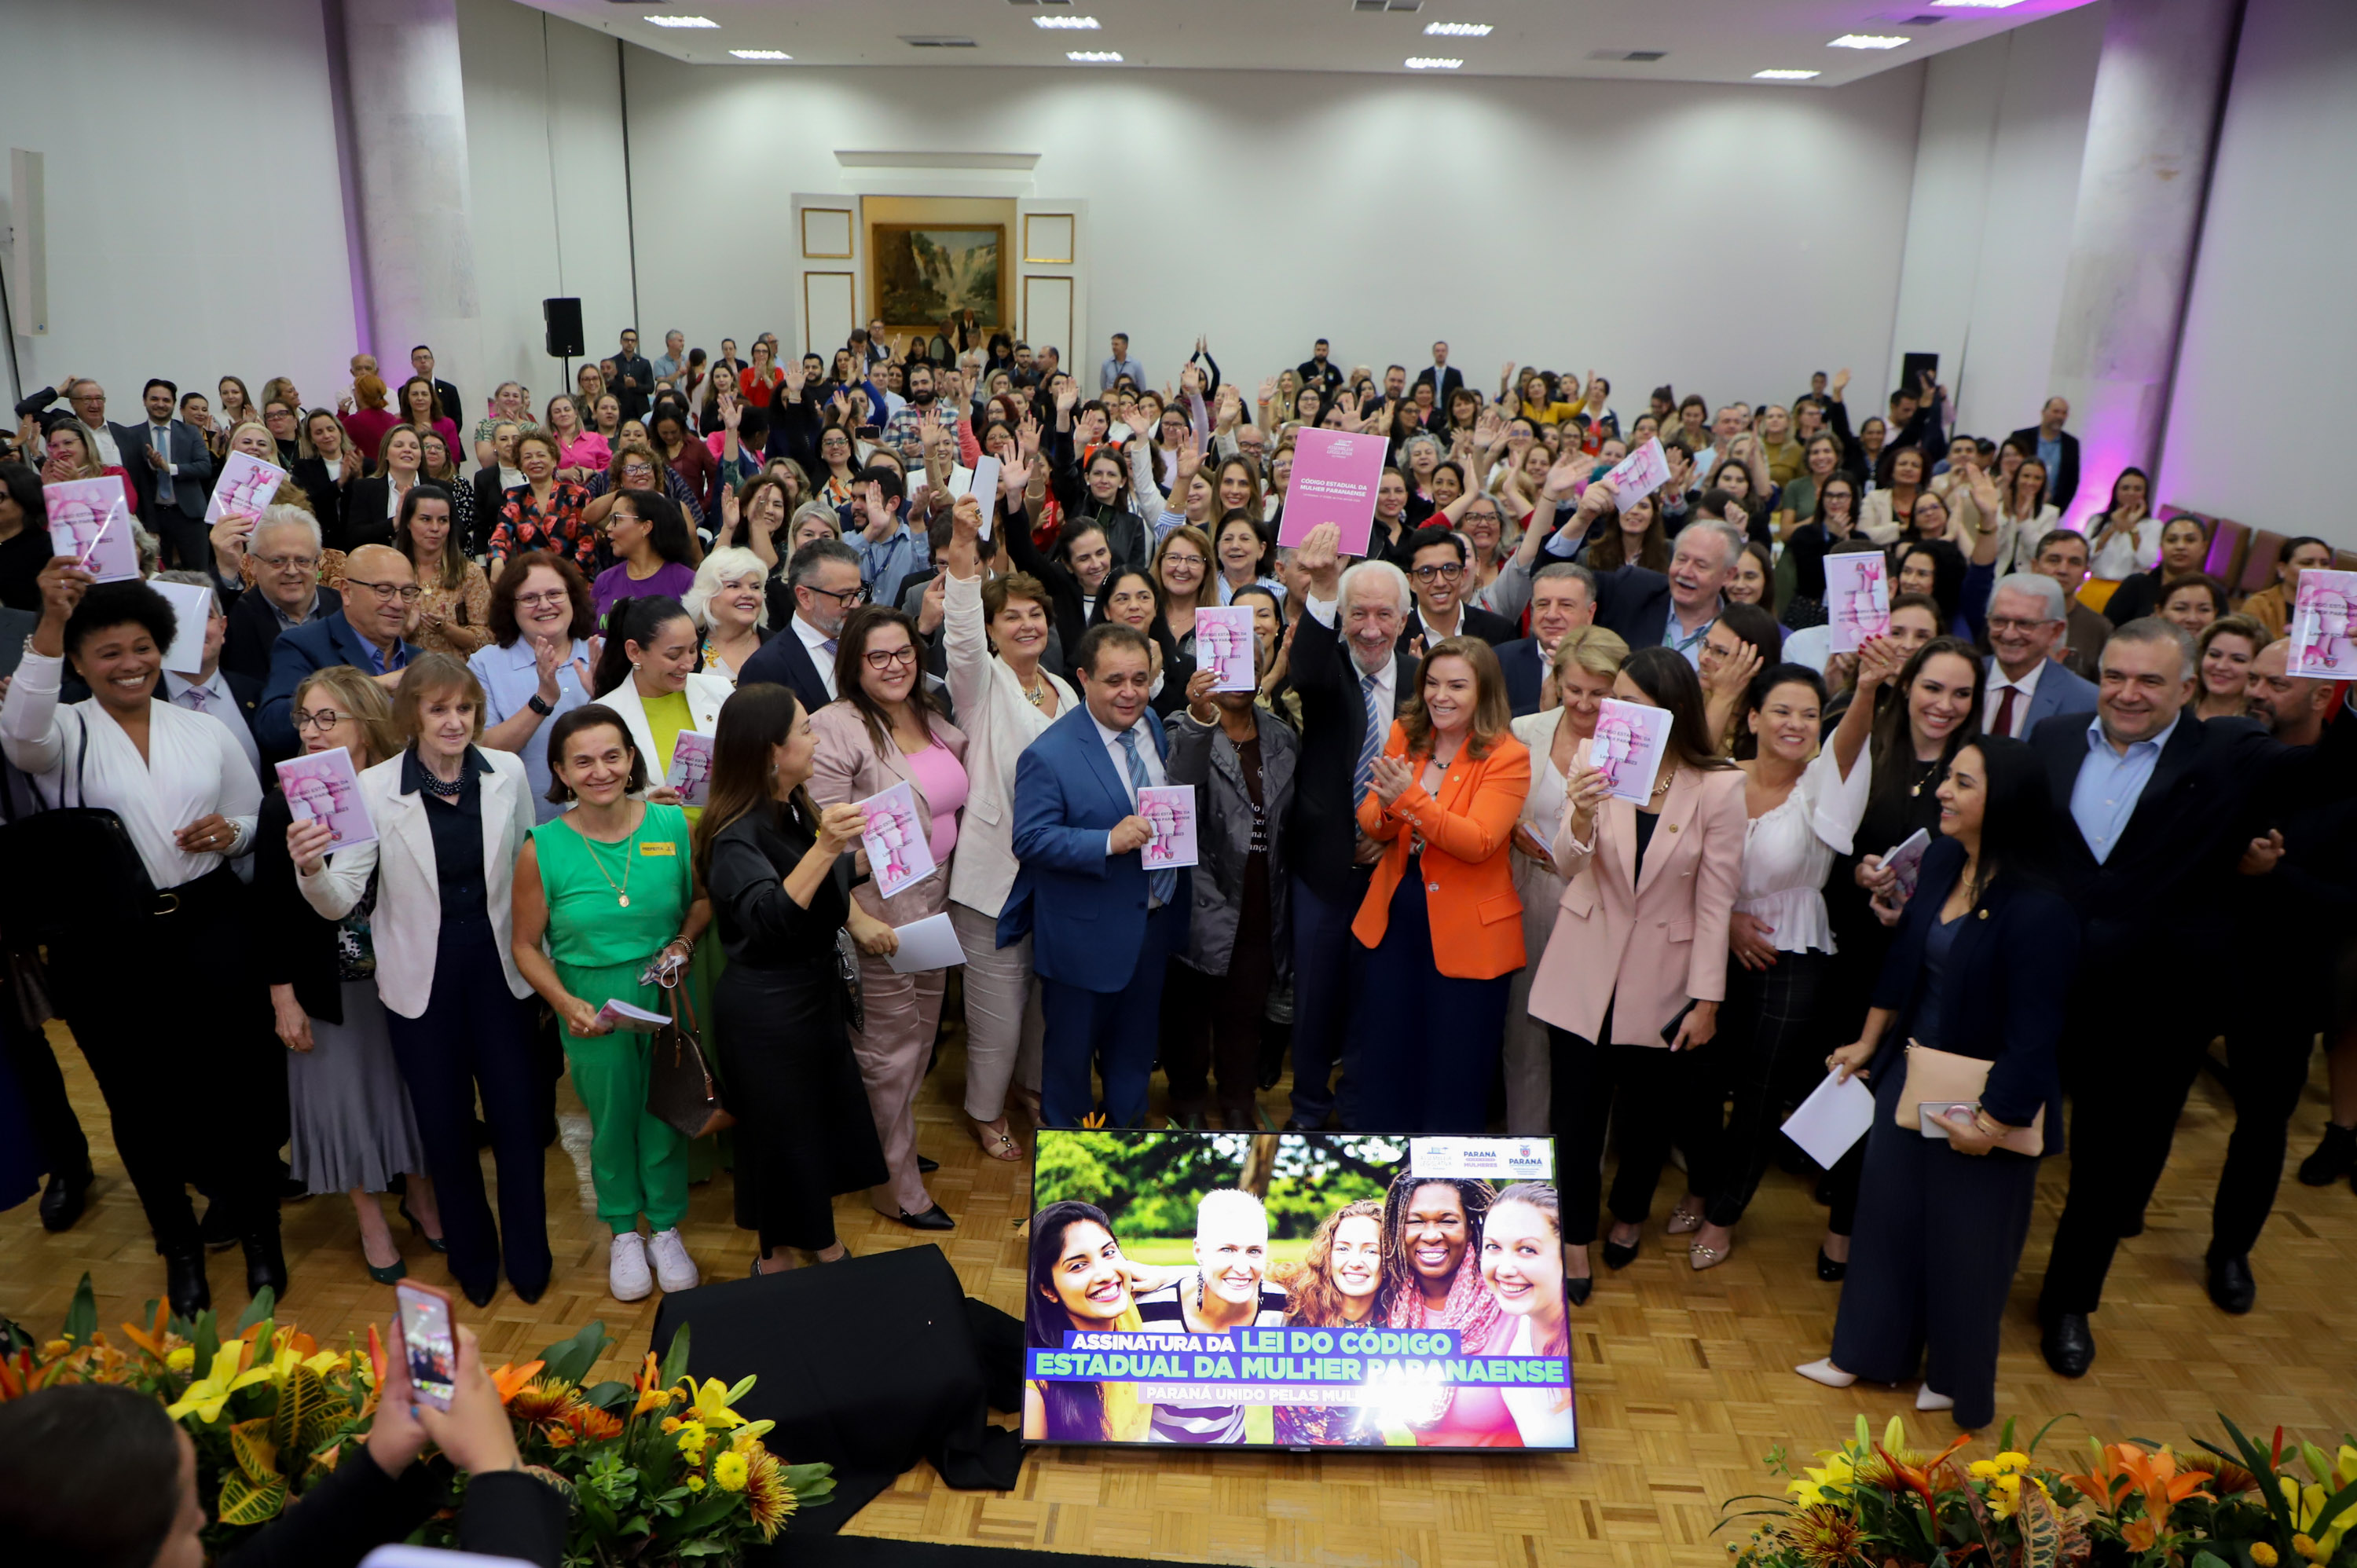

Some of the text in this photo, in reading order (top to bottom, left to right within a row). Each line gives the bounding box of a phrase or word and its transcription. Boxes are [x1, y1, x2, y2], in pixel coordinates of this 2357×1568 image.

[1300, 477, 1325, 486] CÓDIGO
[1325, 481, 1358, 490] ESTADUAL
[1300, 484, 1367, 497] MULHER PARANAENSE
[1071, 1328, 1453, 1356] ASSINATURA DA LEI DO CÓDIGO
[1036, 1353, 1565, 1383] ESTADUAL DA MULHER PARANAENSE
[1146, 1383, 1212, 1401] PARANÁ
[1215, 1387, 1266, 1401] UNIDO
[1269, 1388, 1318, 1402] PELAS
